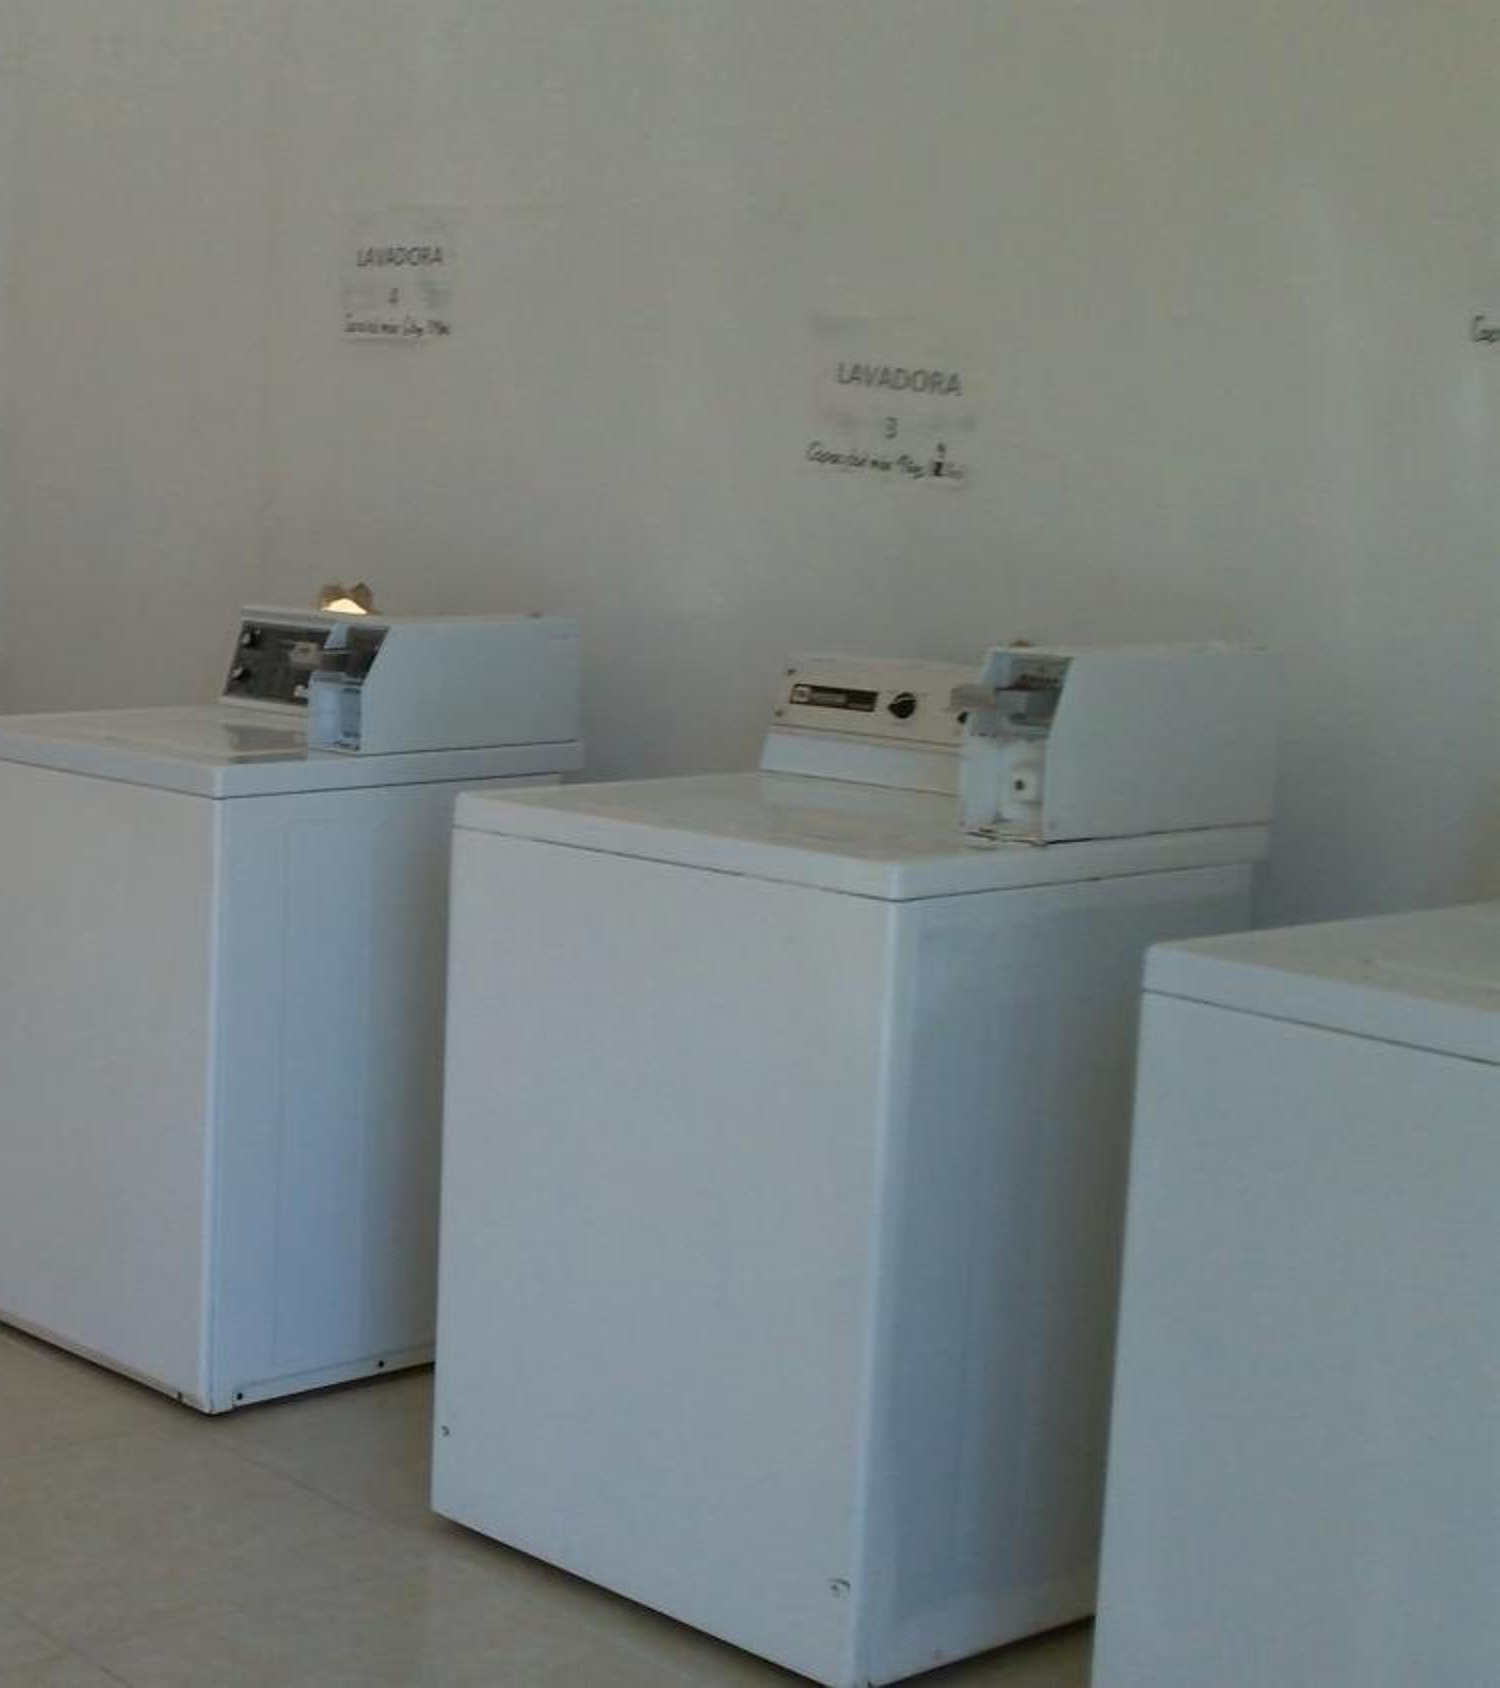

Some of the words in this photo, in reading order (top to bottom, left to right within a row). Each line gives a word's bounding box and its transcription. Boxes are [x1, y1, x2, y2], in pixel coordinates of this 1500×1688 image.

[356, 246, 443, 267] LAVADORA
[837, 362, 963, 397] LAVADORA
[884, 416, 900, 439] 3
